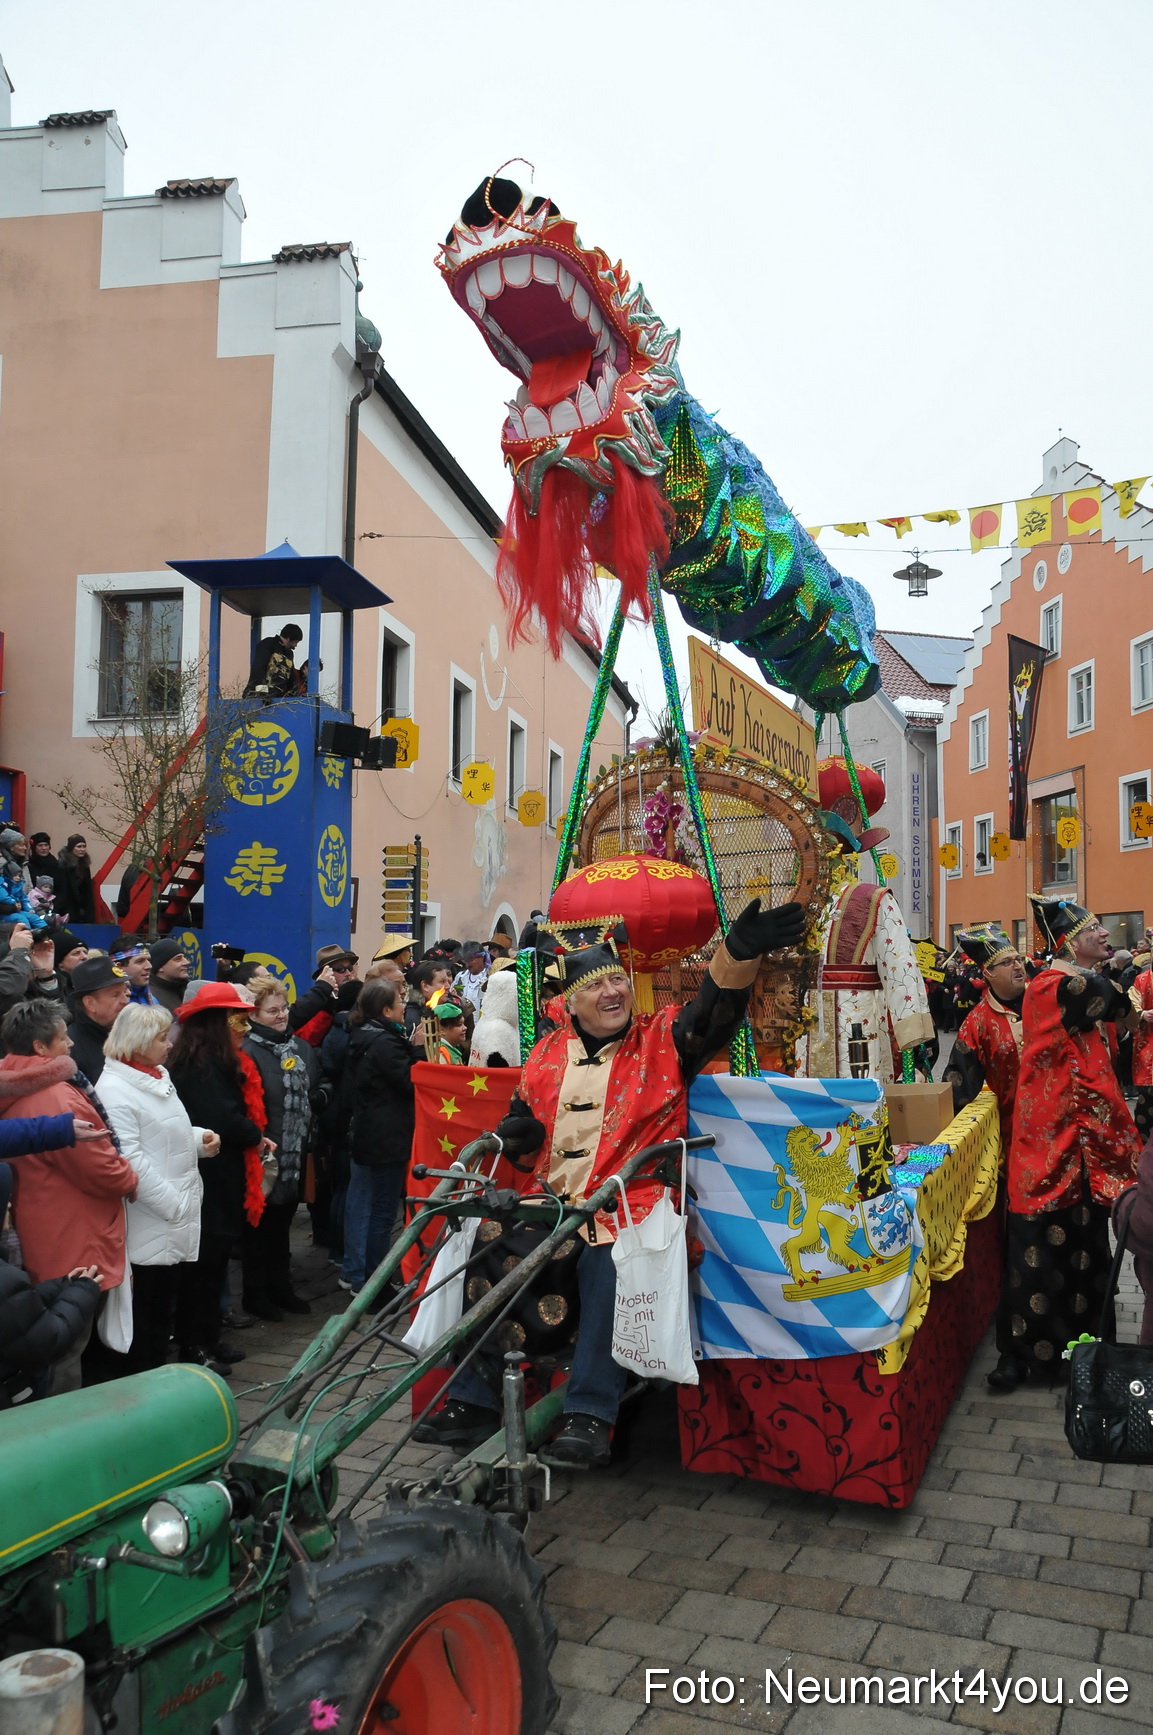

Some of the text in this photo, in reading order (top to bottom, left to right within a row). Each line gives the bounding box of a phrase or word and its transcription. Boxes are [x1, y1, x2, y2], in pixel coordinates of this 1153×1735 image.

[707, 663, 811, 782] Auf Kaisersuche
[912, 773, 922, 911] UHREN SCHMUCK
[634, 1309, 655, 1323] mit
